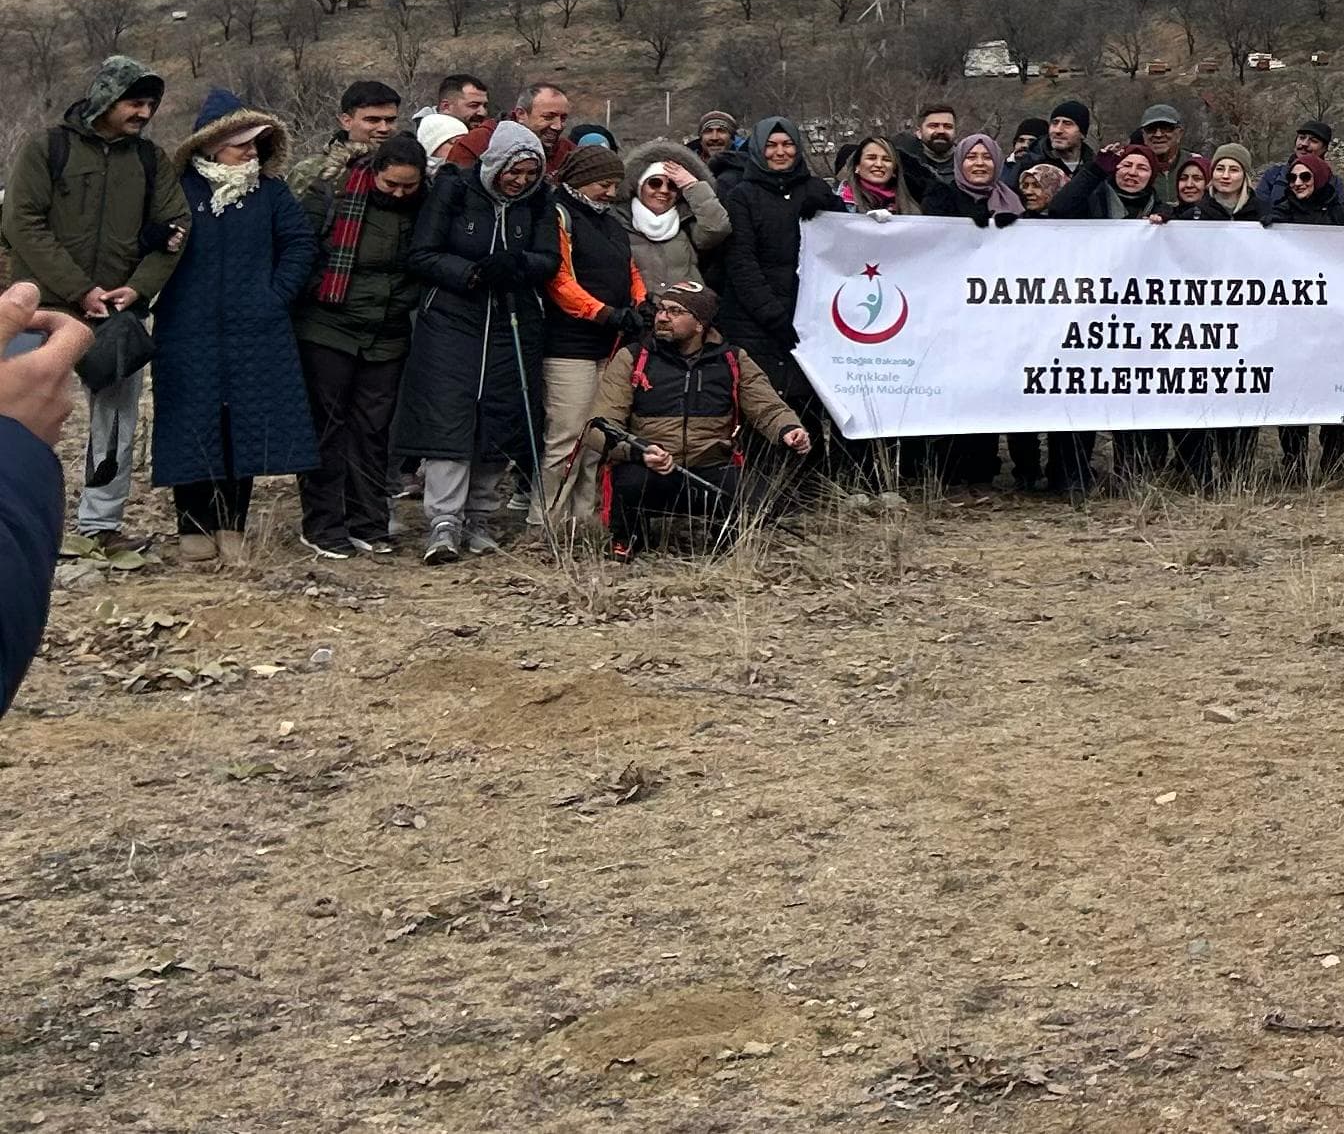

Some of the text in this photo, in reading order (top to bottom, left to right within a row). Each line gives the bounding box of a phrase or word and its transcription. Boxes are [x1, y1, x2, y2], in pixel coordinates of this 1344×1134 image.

[966, 272, 1328, 306] DAMARLARINIZDAKİ
[1061, 313, 1239, 349] ASİL KANI
[1023, 358, 1274, 394] KİRLETMEYİN
